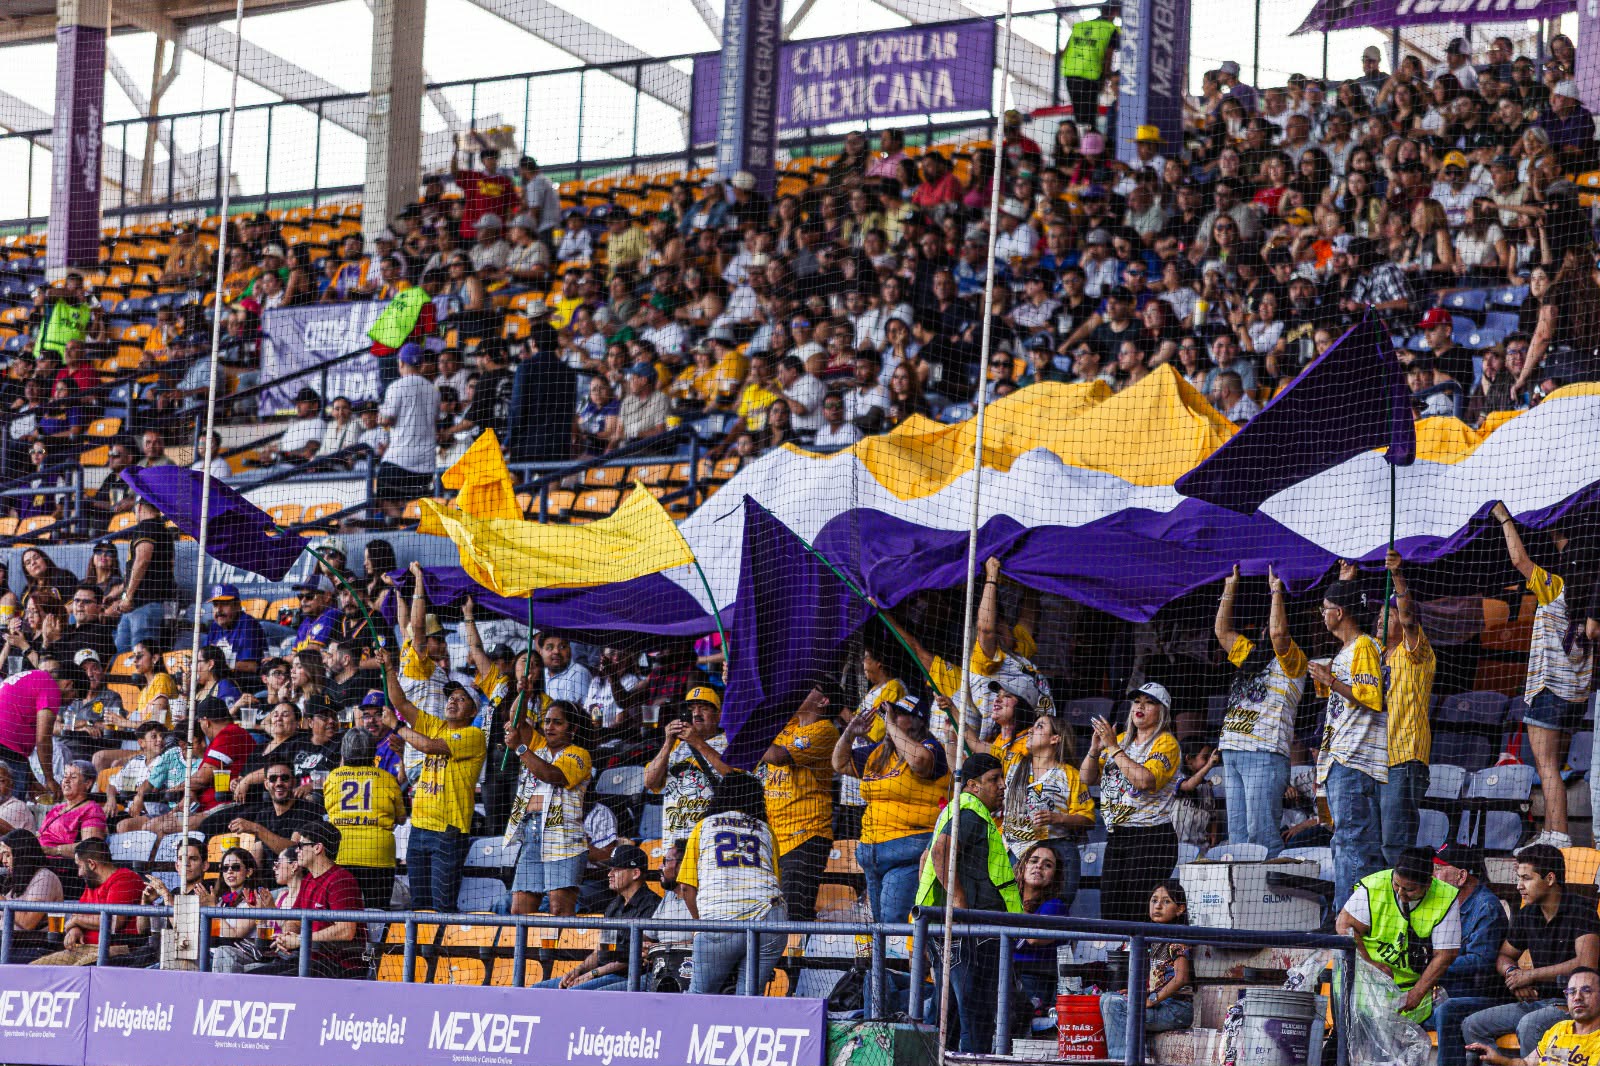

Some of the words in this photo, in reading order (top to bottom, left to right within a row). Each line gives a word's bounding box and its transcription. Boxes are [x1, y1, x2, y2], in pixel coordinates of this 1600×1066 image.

[791, 42, 851, 78] CAJA
[856, 31, 958, 68] POPULAR
[1119, 0, 1140, 97] MEXB
[791, 69, 957, 122] MEXICANA
[1353, 673, 1379, 687] RADOS
[341, 780, 372, 812] 21
[677, 795, 711, 810] Porr
[715, 831, 761, 868] 23
[1262, 894, 1292, 904] GILDAN
[1376, 940, 1408, 968] TECAT
[93, 1001, 174, 1037] ¡Juégatela!
[192, 998, 296, 1040] MEXBET
[319, 1012, 407, 1050] ¡Juégatela!
[428, 1010, 541, 1055] MEXBET
[567, 1026, 662, 1066] ¡Juégatela!
[686, 1023, 810, 1066] MEXBET
